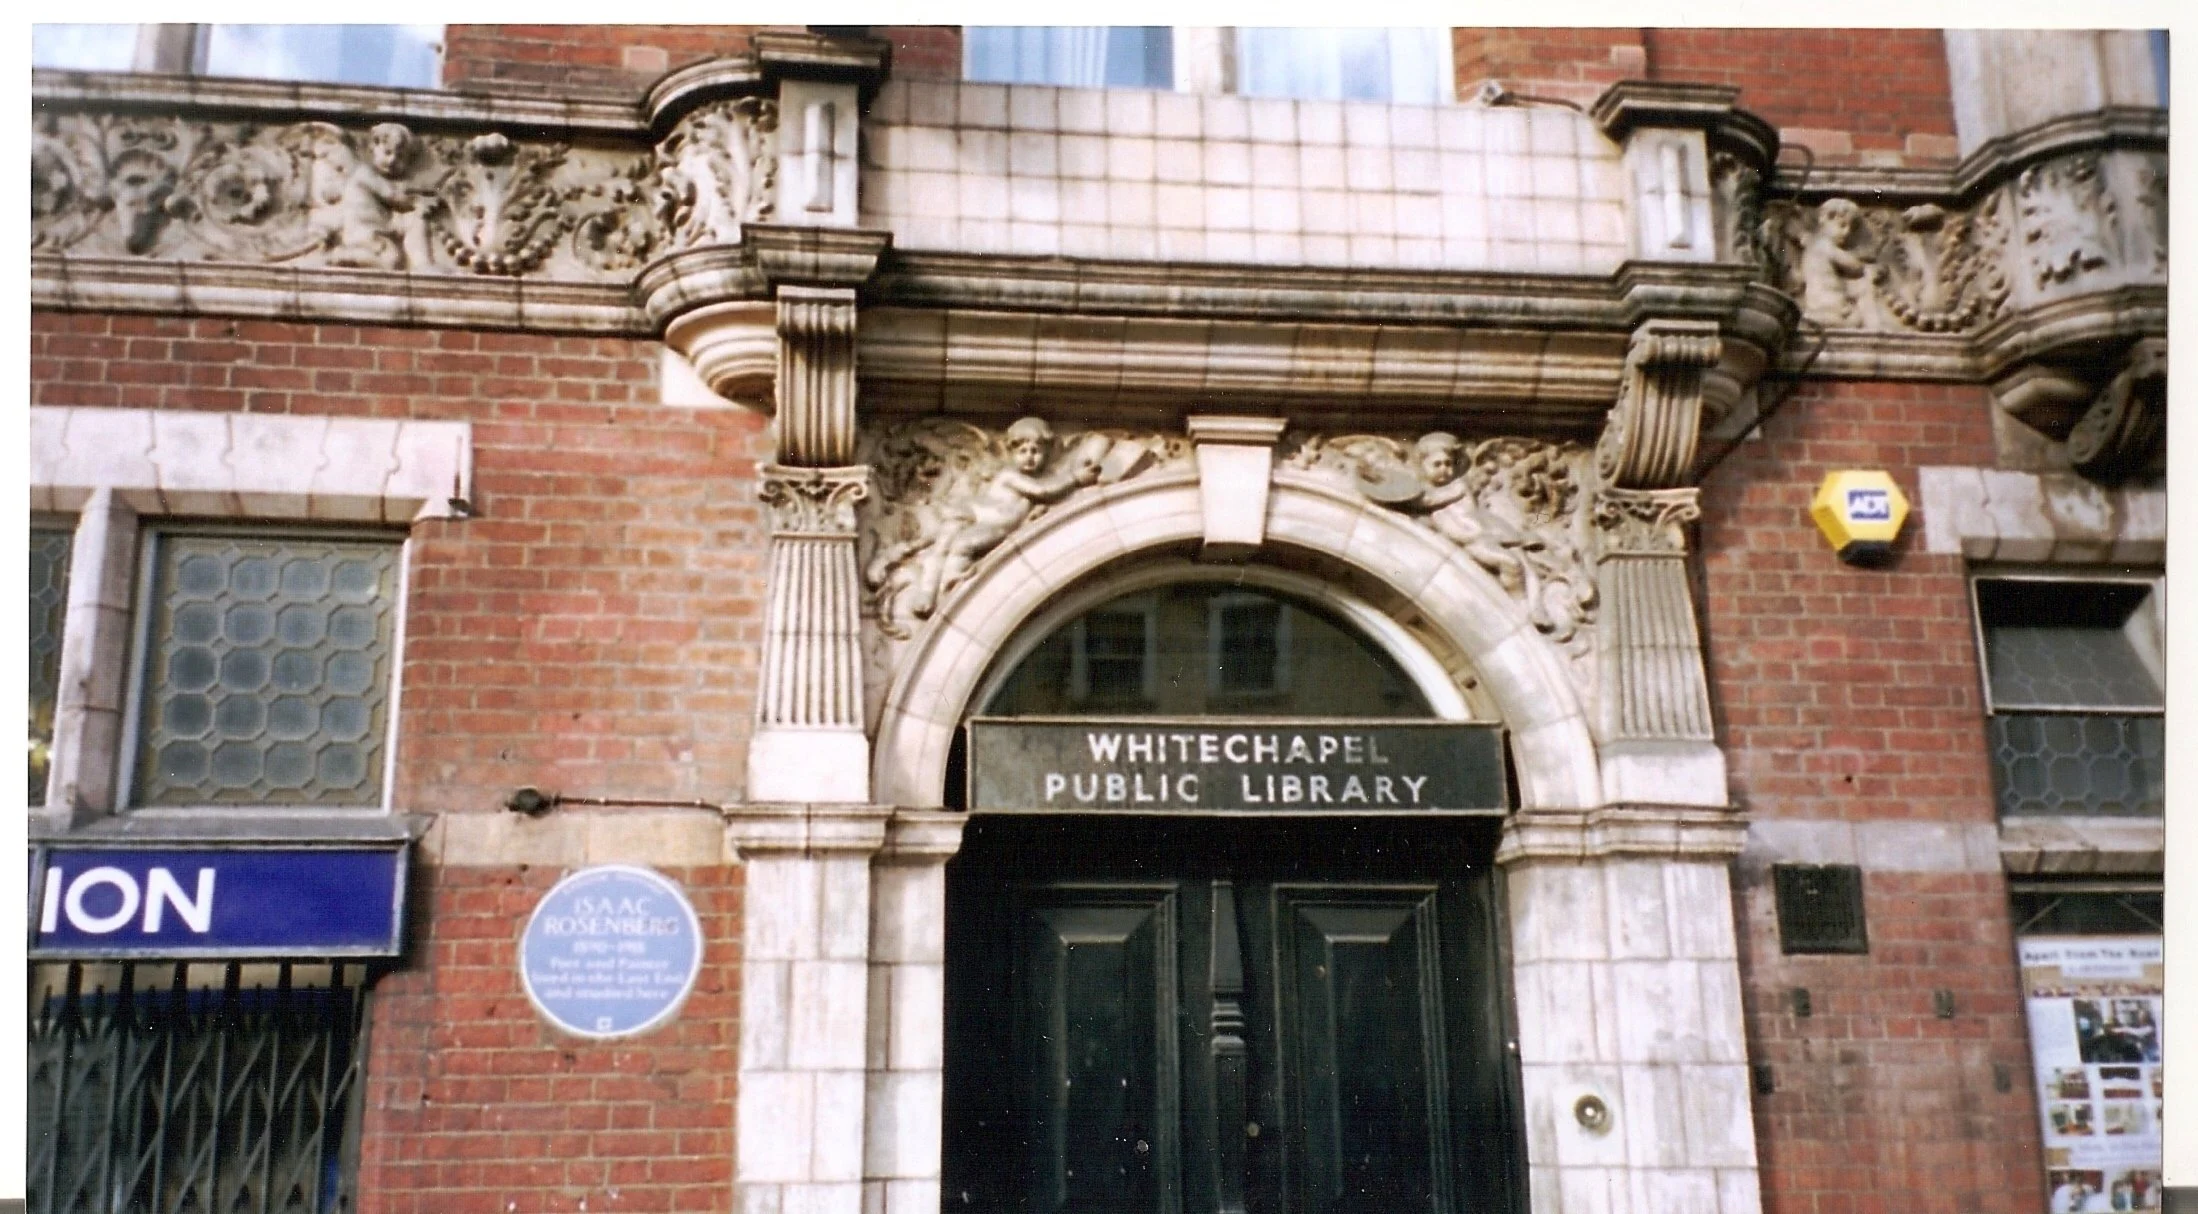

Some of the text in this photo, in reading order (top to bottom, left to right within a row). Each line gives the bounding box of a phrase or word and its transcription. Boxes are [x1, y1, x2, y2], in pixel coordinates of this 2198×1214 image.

[1087, 733, 1389, 764] WHITECHAPEL
[1045, 773, 1428, 804] PUBLIC LIBRARY
[40, 866, 216, 934] ION
[573, 896, 651, 916] ISAAC
[543, 916, 680, 936] ROSENBERG
